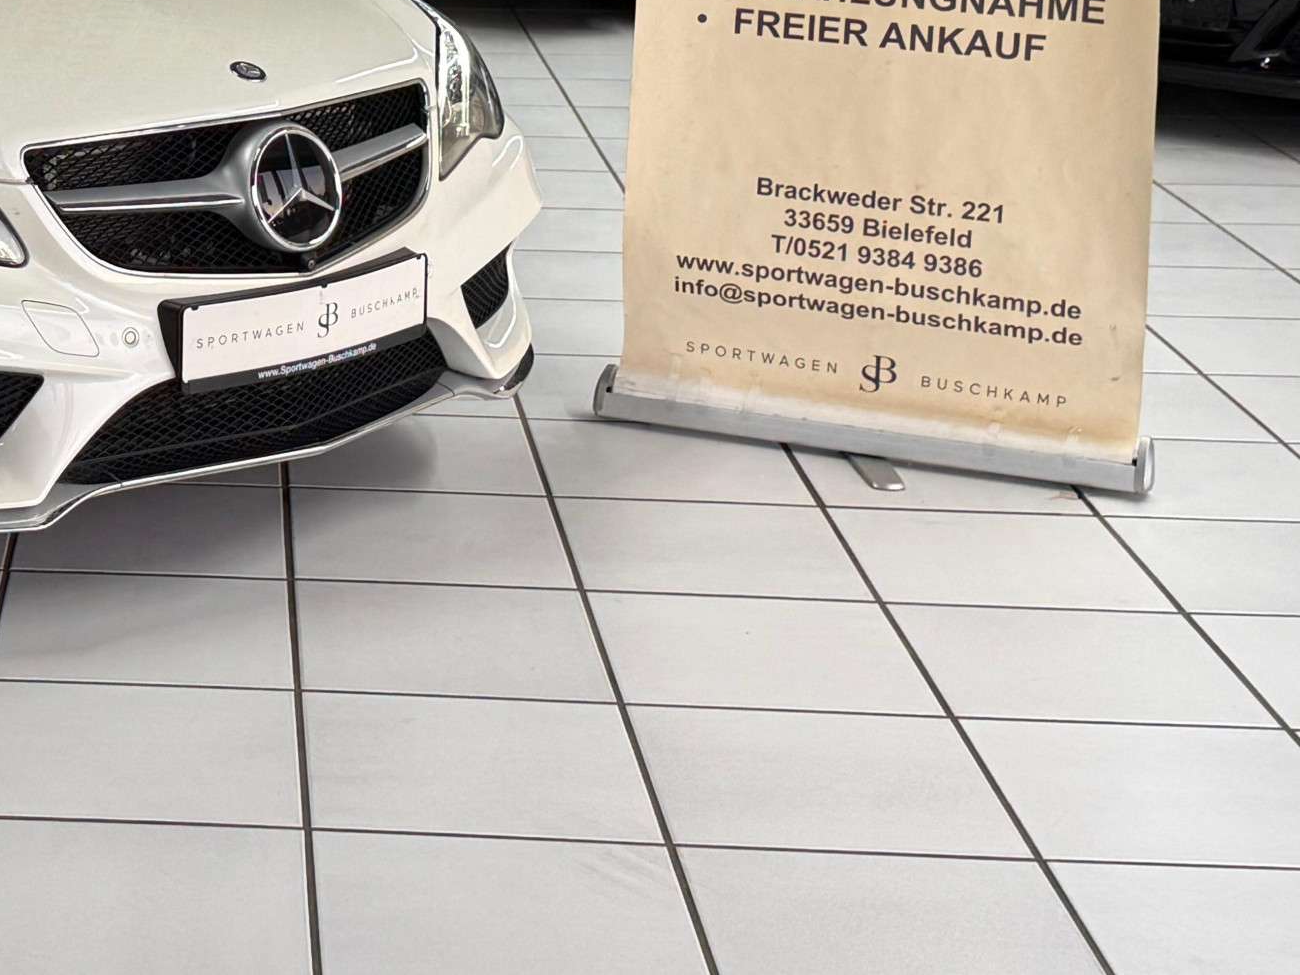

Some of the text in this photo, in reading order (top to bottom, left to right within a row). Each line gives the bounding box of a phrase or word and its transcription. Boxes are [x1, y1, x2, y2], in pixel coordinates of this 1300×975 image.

[734, 7, 1047, 62] FREIER ANKAUF
[756, 176, 1004, 224] Brackweder Str. 221
[771, 234, 982, 278] T/0521 9384 9386
[784, 208, 973, 249] 33659 Bielefeld
[674, 275, 1083, 346] info@sportwagen-buschkamp.de
[676, 254, 1082, 320] www.sportwagen-buschkamp.de
[196, 321, 305, 350] SPORTWAGEN
[350, 287, 419, 319] BUSCHKAMP
[258, 342, 377, 379] www.Sportwagen-Buschkamp.de
[686, 340, 838, 374] SPORTWAGEN
[920, 375, 1067, 408] BUSCHKAMP
